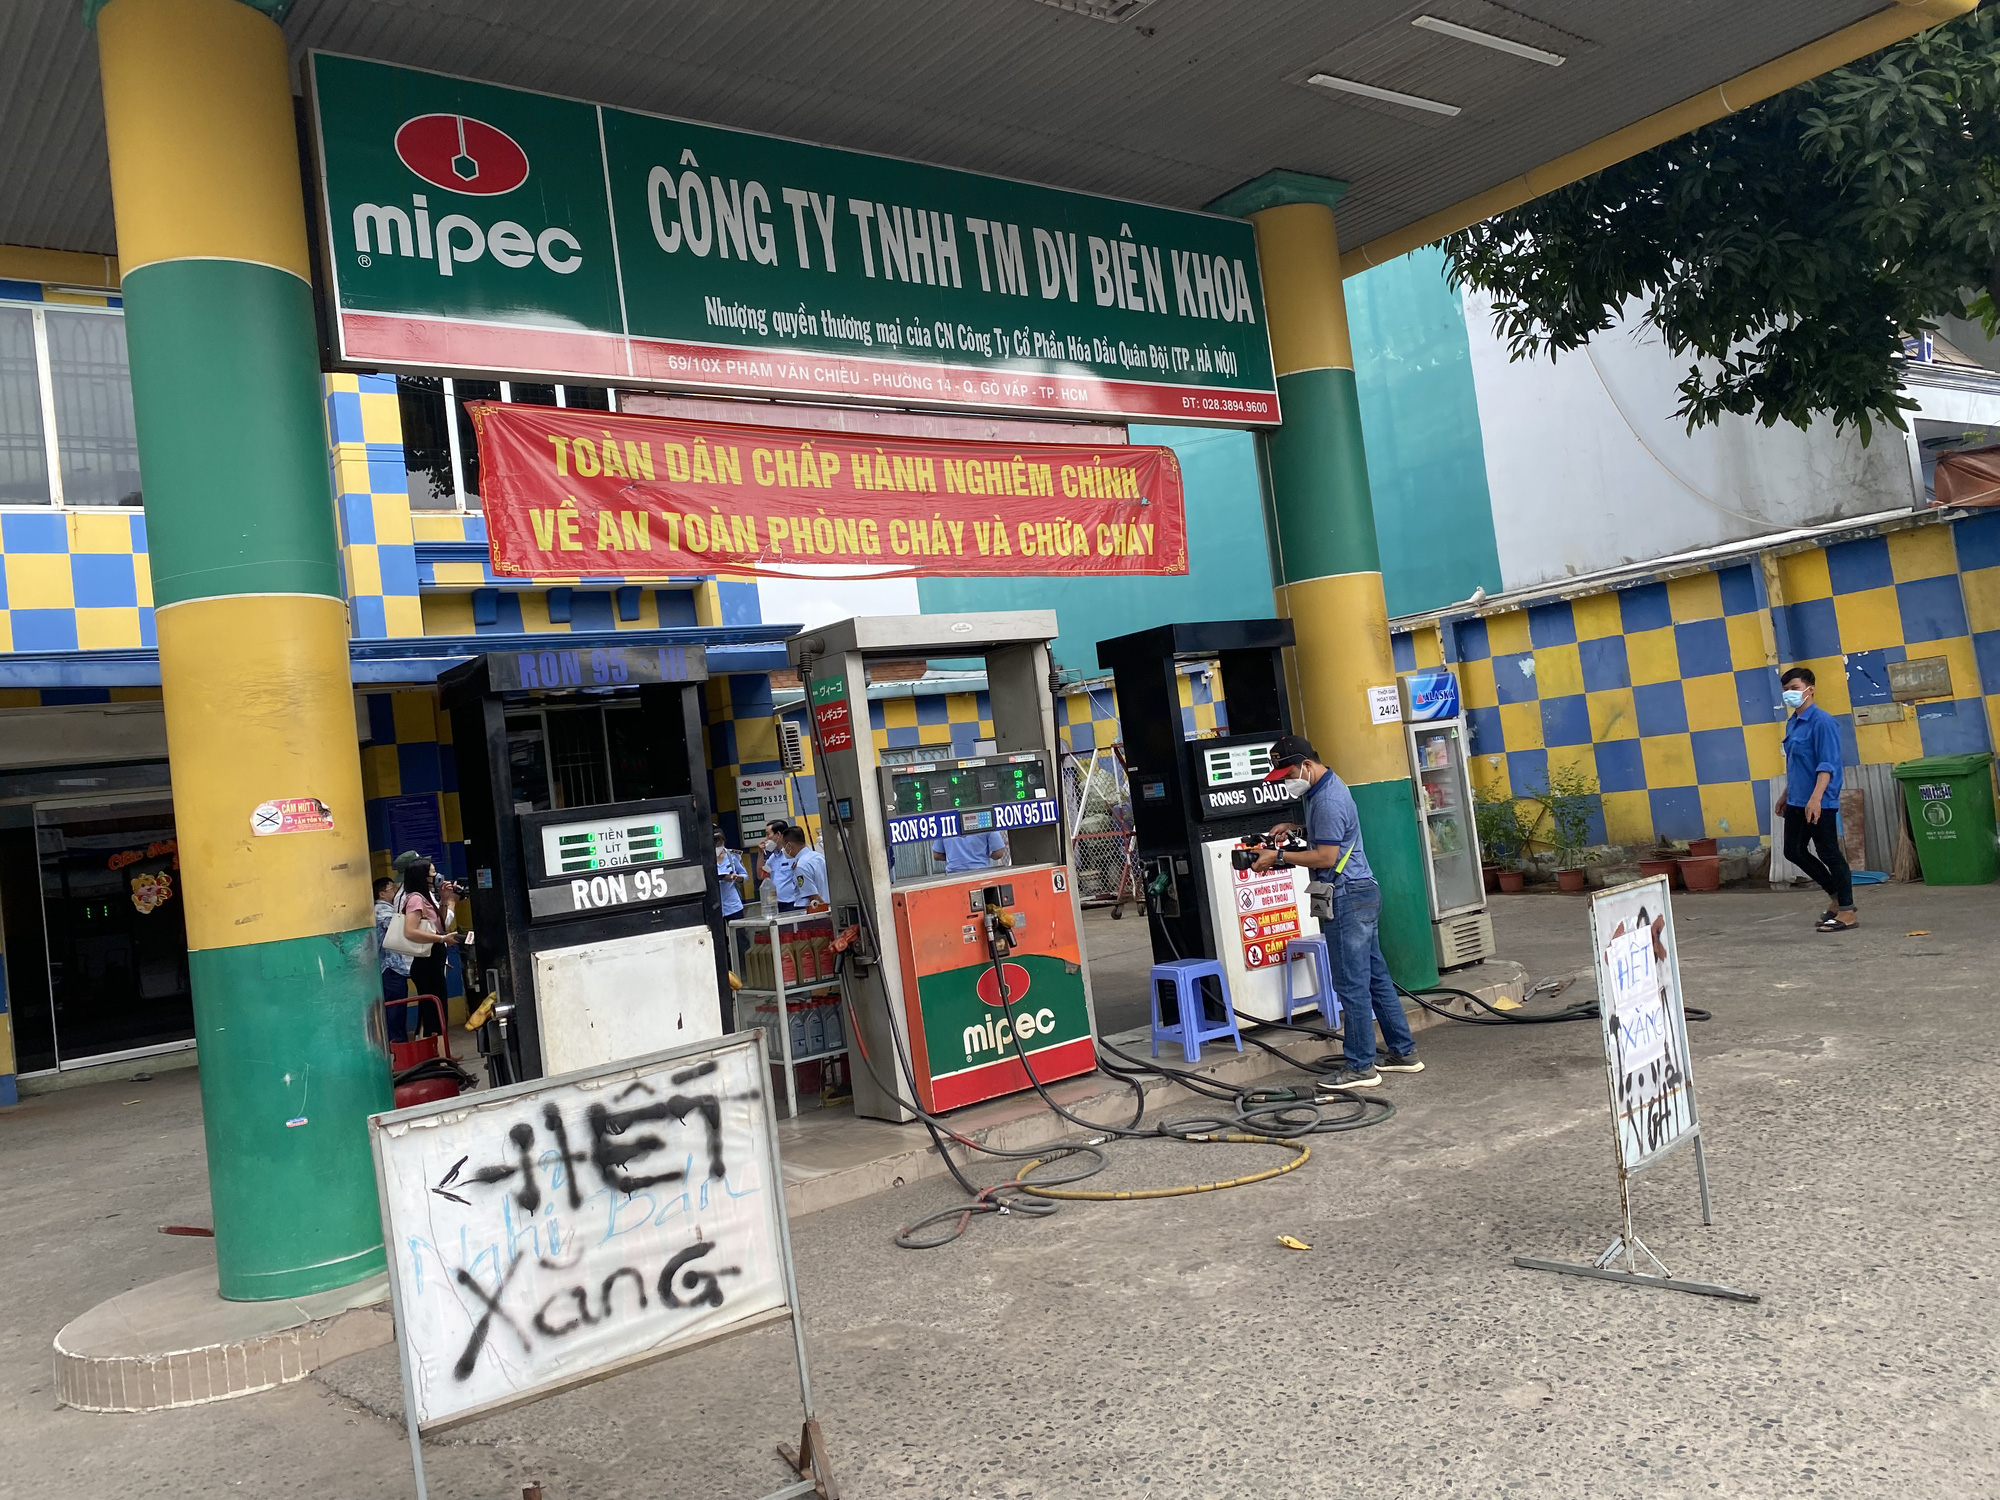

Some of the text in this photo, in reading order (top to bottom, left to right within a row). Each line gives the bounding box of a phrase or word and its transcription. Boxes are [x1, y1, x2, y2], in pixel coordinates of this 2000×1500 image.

[353, 194, 582, 276] mipec
[647, 148, 1256, 325] CÔNG TY TNHH TM DV BIÊN KHOA
[704, 295, 1239, 379] Nhượng quyền thương mại của CN Công Ty Cổ Phần Hóa Dầu Quân Đội (TP. HÀ NỘI)
[668, 355, 722, 374] 69/10X
[726, 360, 773, 379] PHẠM
[777, 361, 810, 381] VĂN
[813, 366, 860, 386] CHIÊU
[873, 370, 933, 391] PHƯỜNG
[937, 378, 951, 392] 14
[963, 380, 977, 394] Q.
[980, 377, 1000, 396] GÒ
[1004, 377, 1028, 398] VẤP
[1039, 386, 1059, 400] TP.
[1061, 388, 1088, 402] HCM
[1182, 396, 1268, 414] ĐT: 028.3894.9600
[547, 430, 1140, 500] TOÀN DÂN CHẤP HÀNH NGHIÊM CHỈNH
[528, 495, 1155, 557] VỀ AN TOÀN PHÒNG CHÁY VÀ CHỮA CHÁY
[517, 651, 583, 688] RON
[591, 648, 629, 683] 95
[657, 647, 688, 682] III
[821, 707, 848, 723] レギュラー
[824, 732, 851, 747] レギュラー
[1208, 789, 1247, 808] RON95
[995, 800, 1057, 828] RON 95 III
[598, 827, 624, 841] TIỀN
[890, 815, 958, 844] RON 95 III
[605, 842, 621, 854] LÍT
[571, 867, 668, 910] RON 95
[1263, 921, 1296, 936] NO SMOKING
[1268, 953, 1280, 964] NO
[963, 1008, 1056, 1055] mipec
